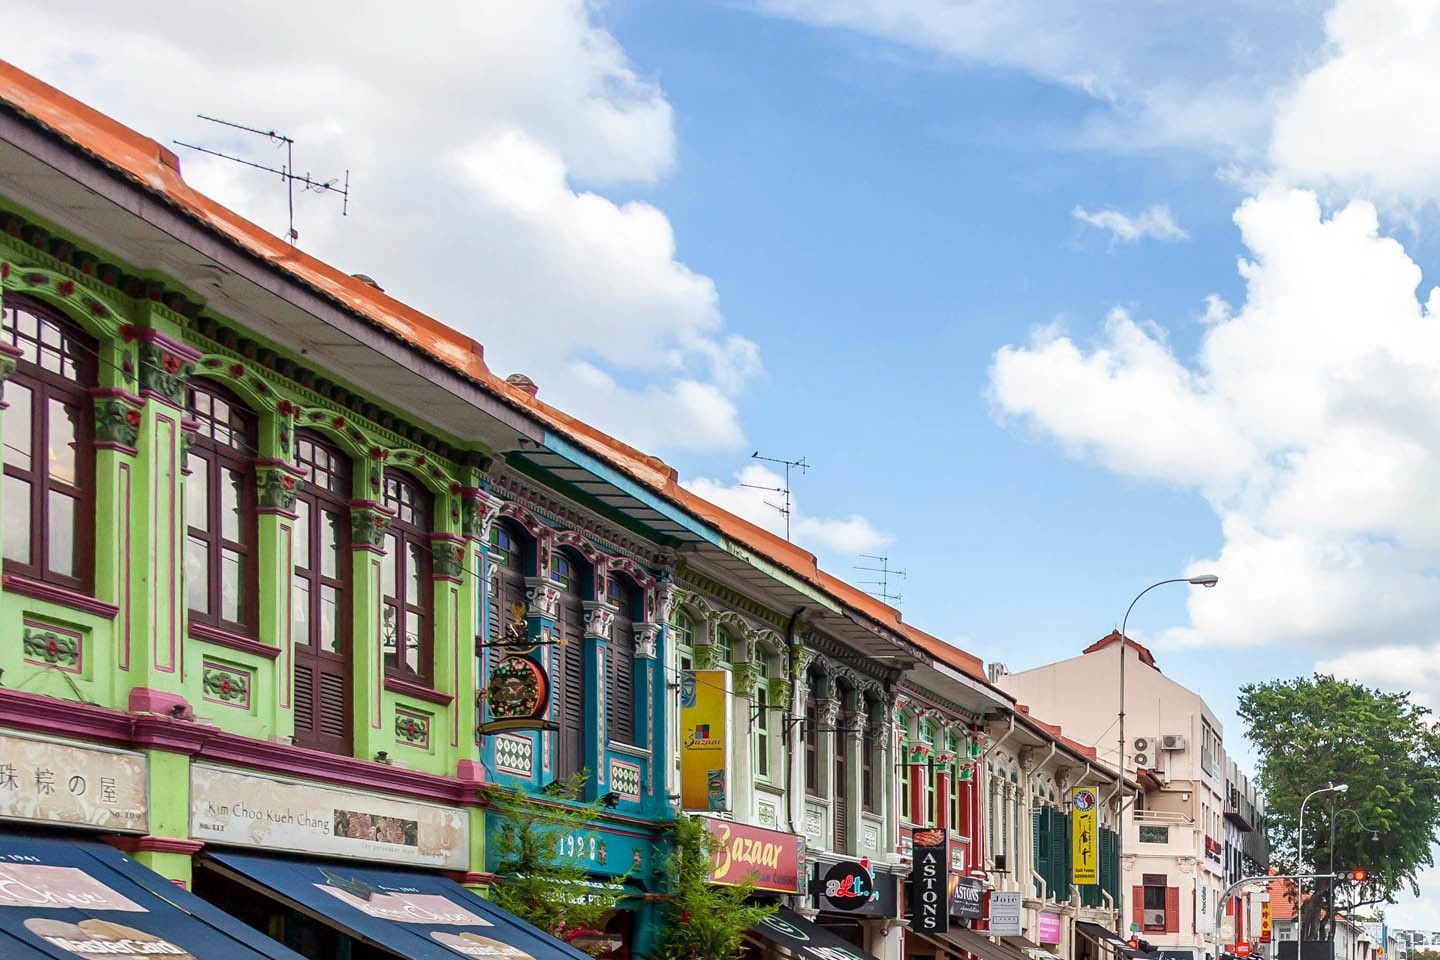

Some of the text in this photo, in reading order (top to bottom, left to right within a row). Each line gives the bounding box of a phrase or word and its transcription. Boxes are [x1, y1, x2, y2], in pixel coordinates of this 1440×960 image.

[208, 801, 330, 835] Kim Choo Kueh Chang
[559, 834, 596, 861] 1928
[713, 824, 783, 880] Bazaar
[922, 852, 937, 929] ASTONS
[954, 885, 979, 902] ASTONS
